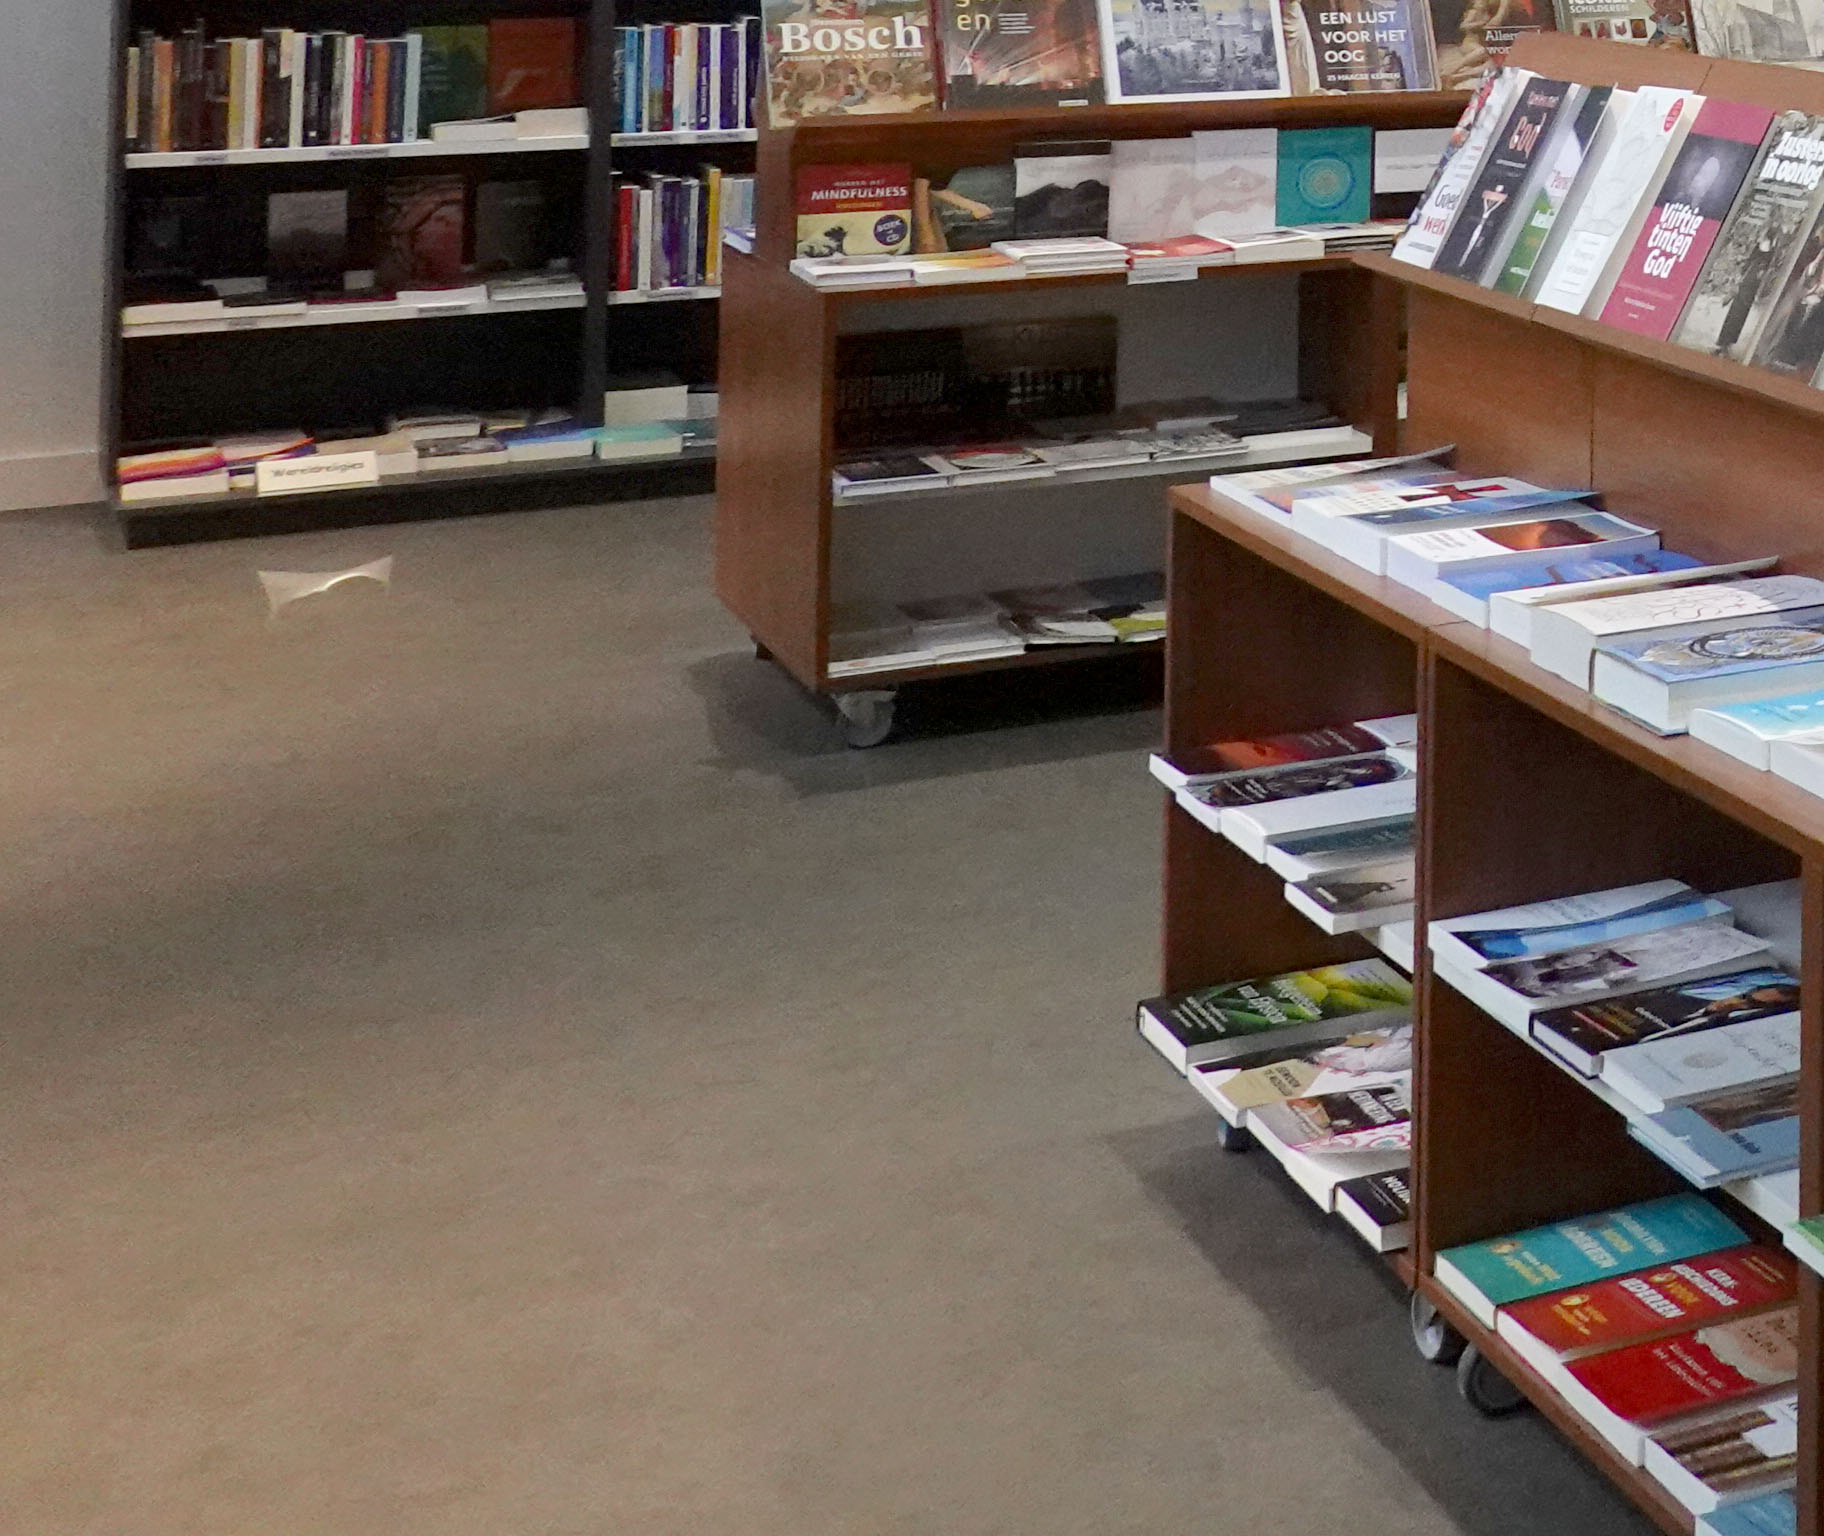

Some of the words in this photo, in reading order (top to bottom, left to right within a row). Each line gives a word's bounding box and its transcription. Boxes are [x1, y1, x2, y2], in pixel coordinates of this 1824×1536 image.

[1569, 4, 1630, 13] SCHILDEREN
[956, 13, 991, 32] en
[1320, 13, 1351, 25] EEN
[1357, 10, 1397, 24] LUST
[777, 15, 925, 54] Bosch
[1322, 30, 1371, 44] VOOR
[1376, 29, 1407, 42] HET
[1324, 50, 1366, 63] OOG
[811, 184, 908, 200] MINDFULNESS
[1662, 201, 1704, 236] Vijftig
[1648, 224, 1694, 263] tinten
[1643, 254, 1680, 280] God
